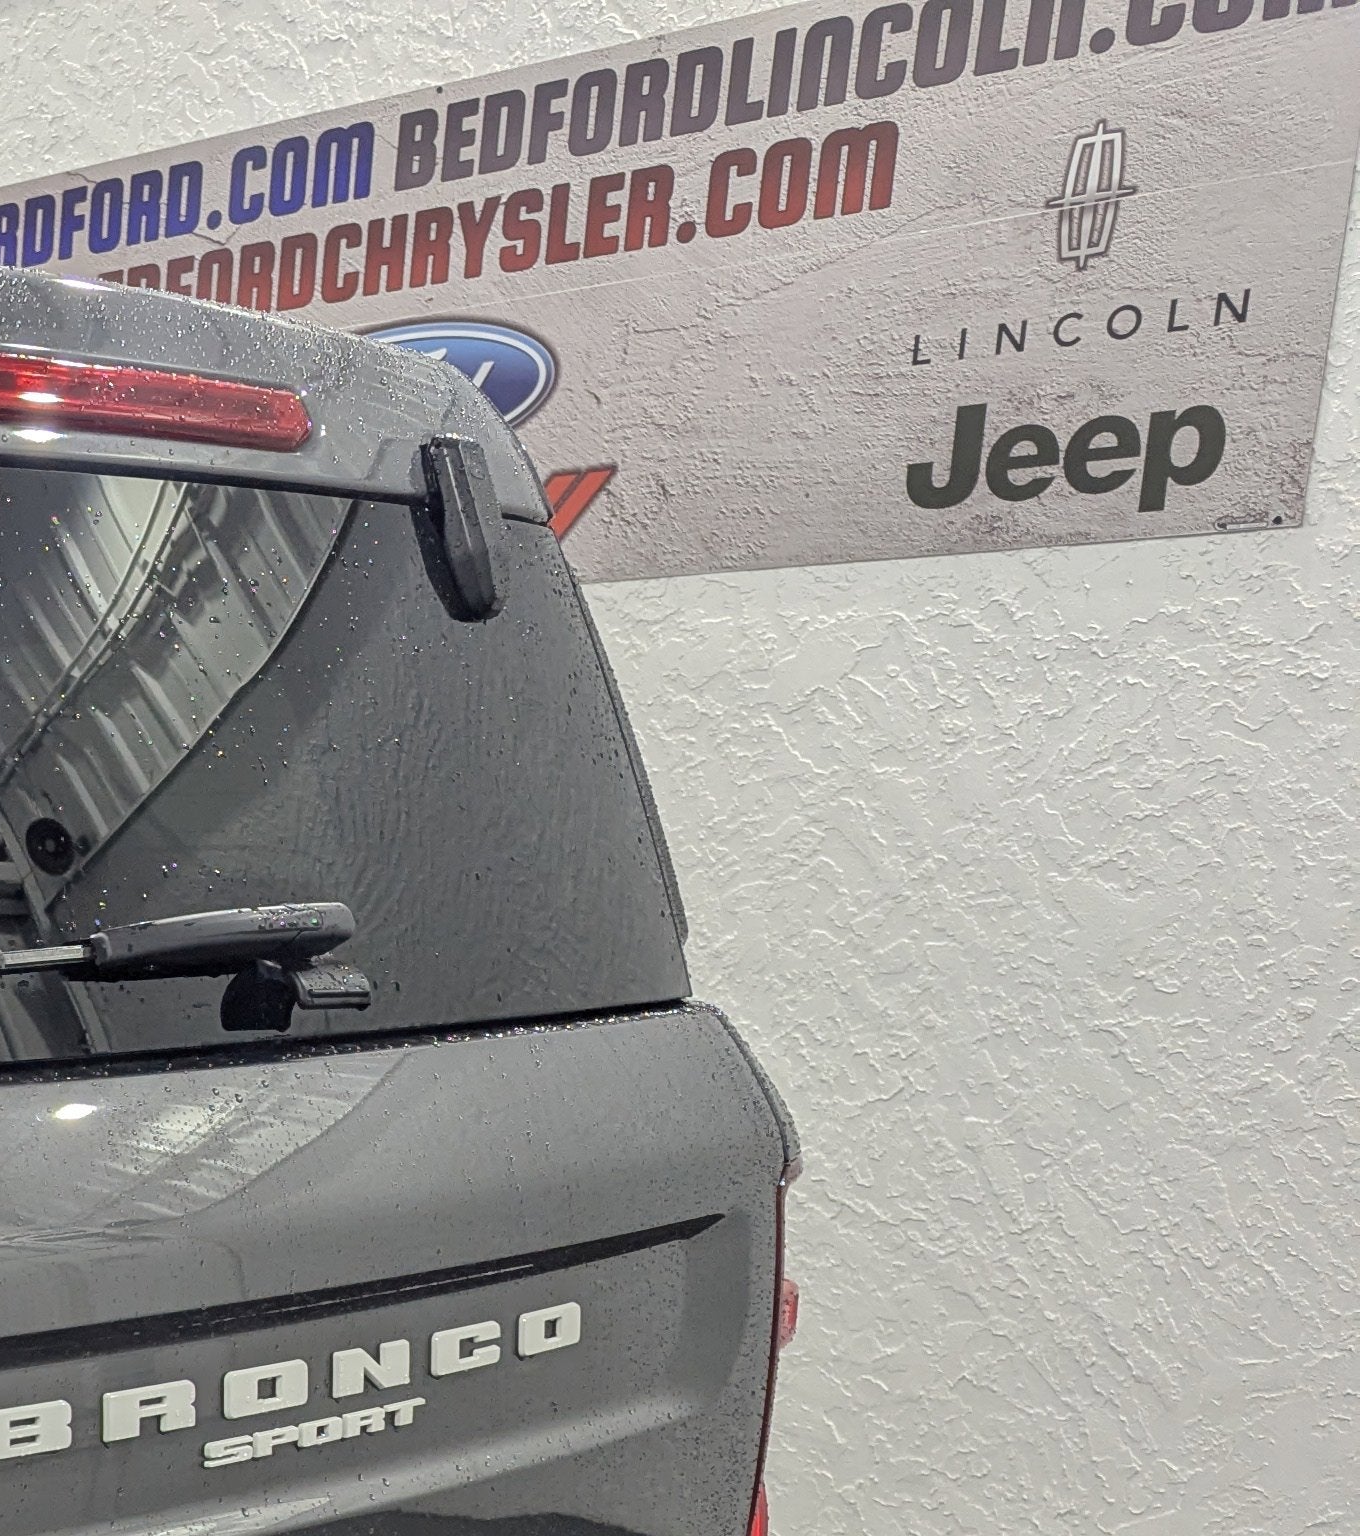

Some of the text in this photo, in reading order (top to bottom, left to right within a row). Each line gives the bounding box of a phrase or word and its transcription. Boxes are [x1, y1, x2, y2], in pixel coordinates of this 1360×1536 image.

[910, 288, 1251, 366] LINCOLN
[906, 403, 1227, 513] Jeep
[202, 1397, 426, 1468] SPORT
